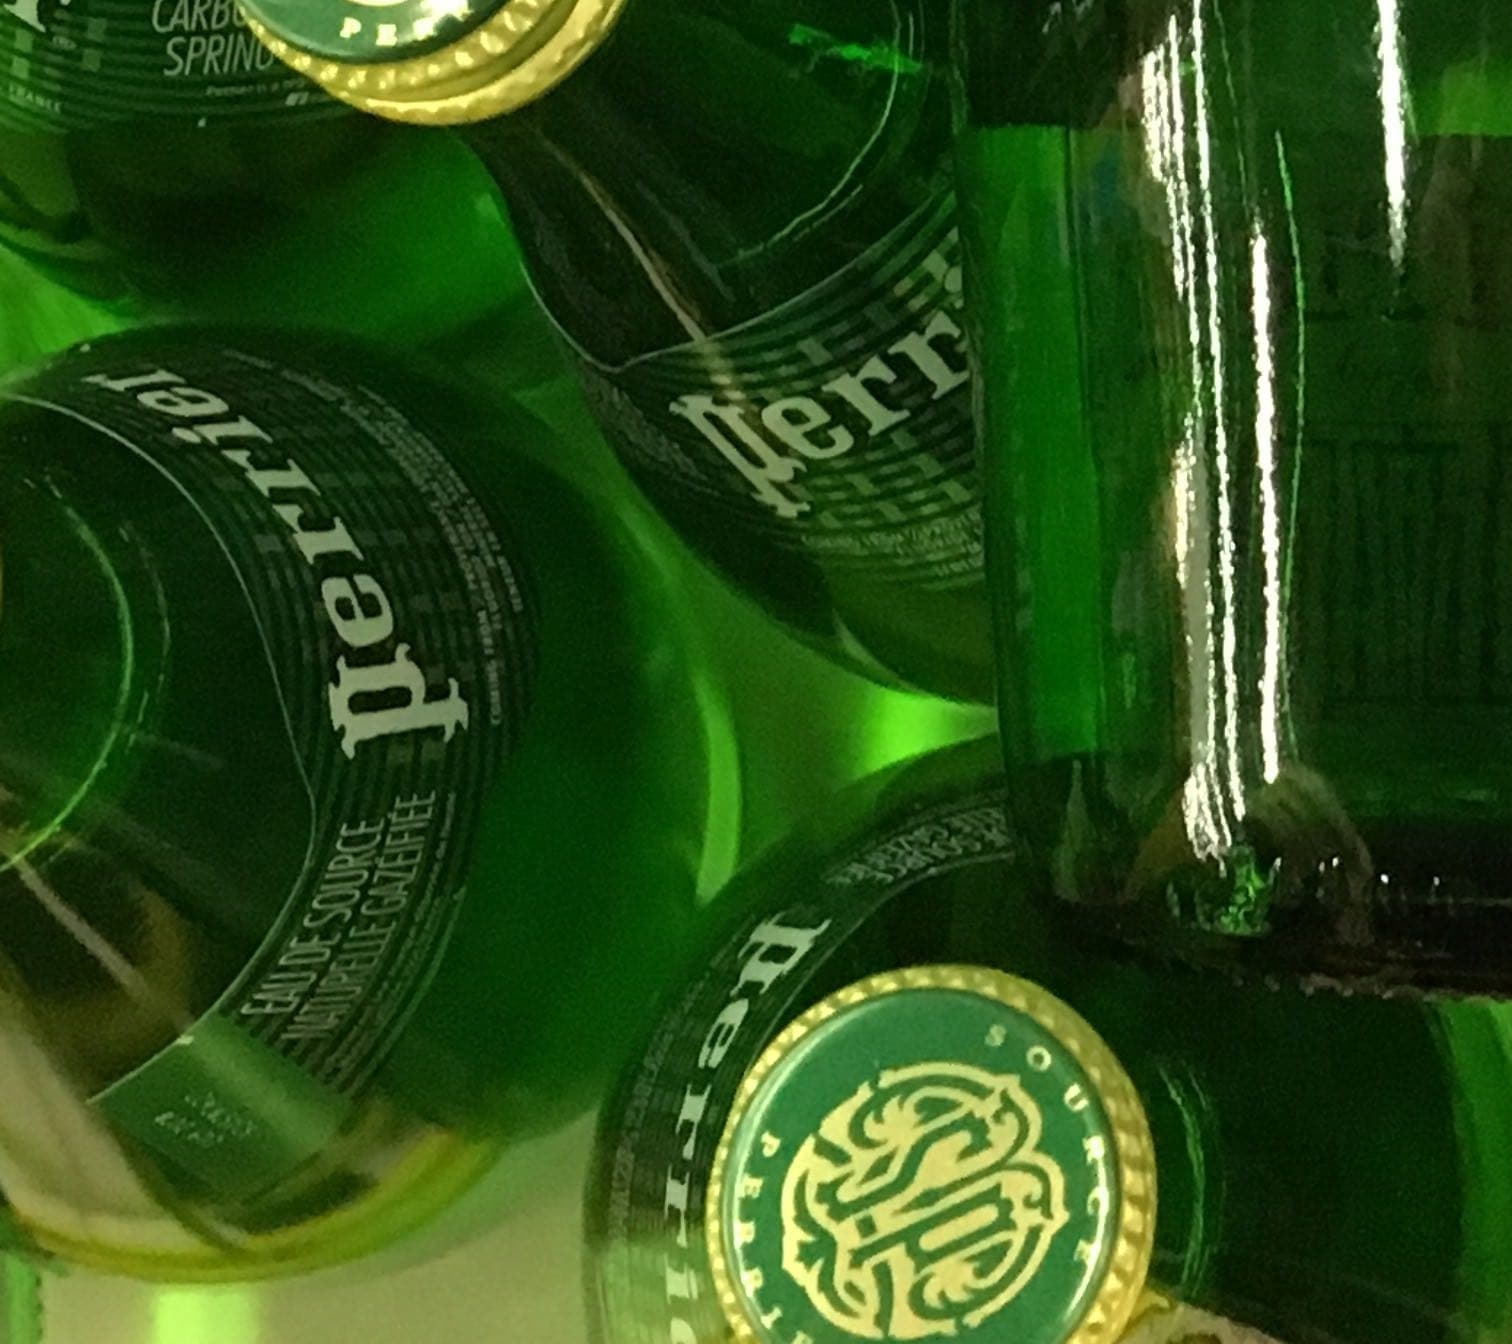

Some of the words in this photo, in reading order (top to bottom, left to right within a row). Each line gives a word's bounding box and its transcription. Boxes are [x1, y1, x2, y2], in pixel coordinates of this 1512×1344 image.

[303, 816, 386, 929] SOURCE
[279, 932, 342, 966] DE
[241, 971, 318, 1015] EAU
